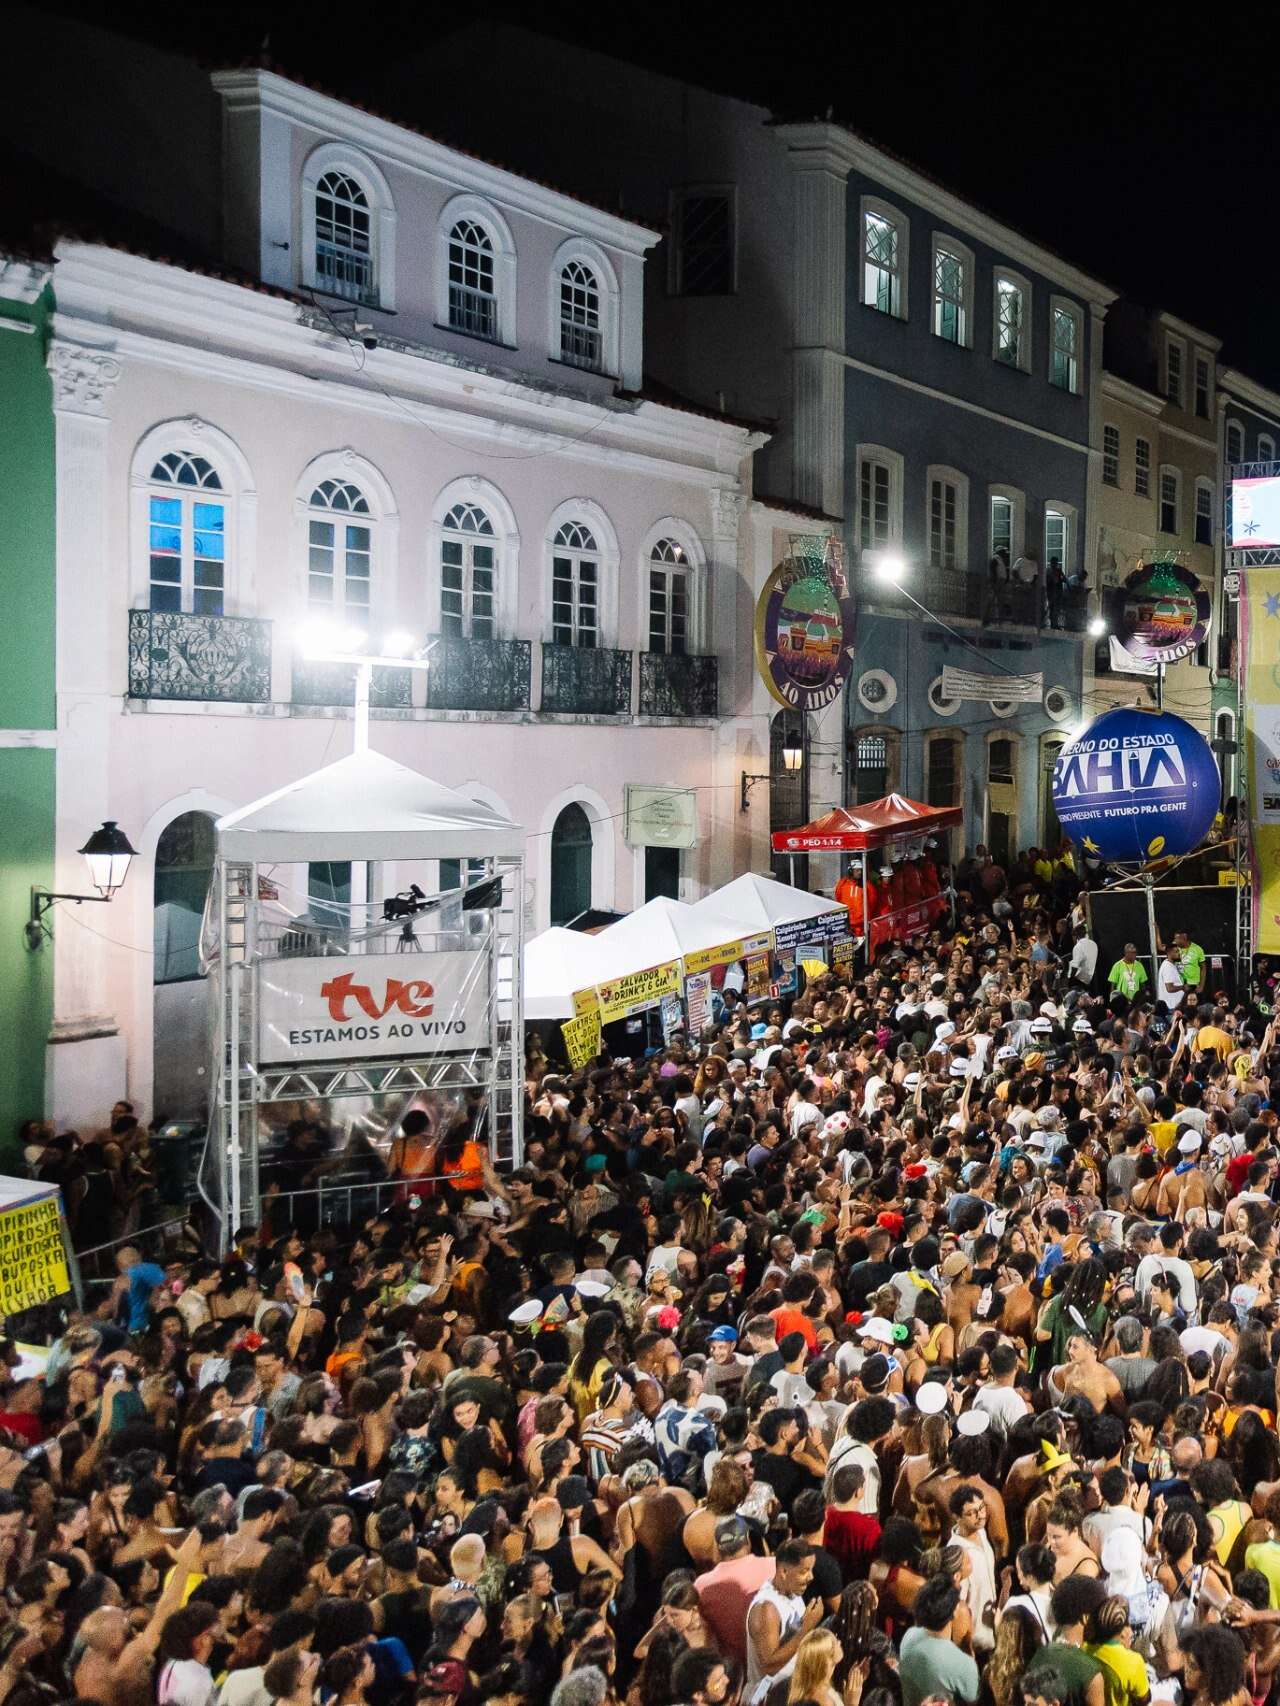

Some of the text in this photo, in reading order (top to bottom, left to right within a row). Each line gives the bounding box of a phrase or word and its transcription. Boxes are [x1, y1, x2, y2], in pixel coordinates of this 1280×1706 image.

[1099, 737, 1119, 750] DO
[1123, 733, 1175, 748] ESTADO
[1104, 806, 1140, 817] FUTURO
[1141, 805, 1158, 814] PRA
[1160, 802, 1187, 812] GENTE
[620, 969, 659, 989] SALVADOR
[289, 1020, 466, 1046] ESTAMOS AO VIVO
